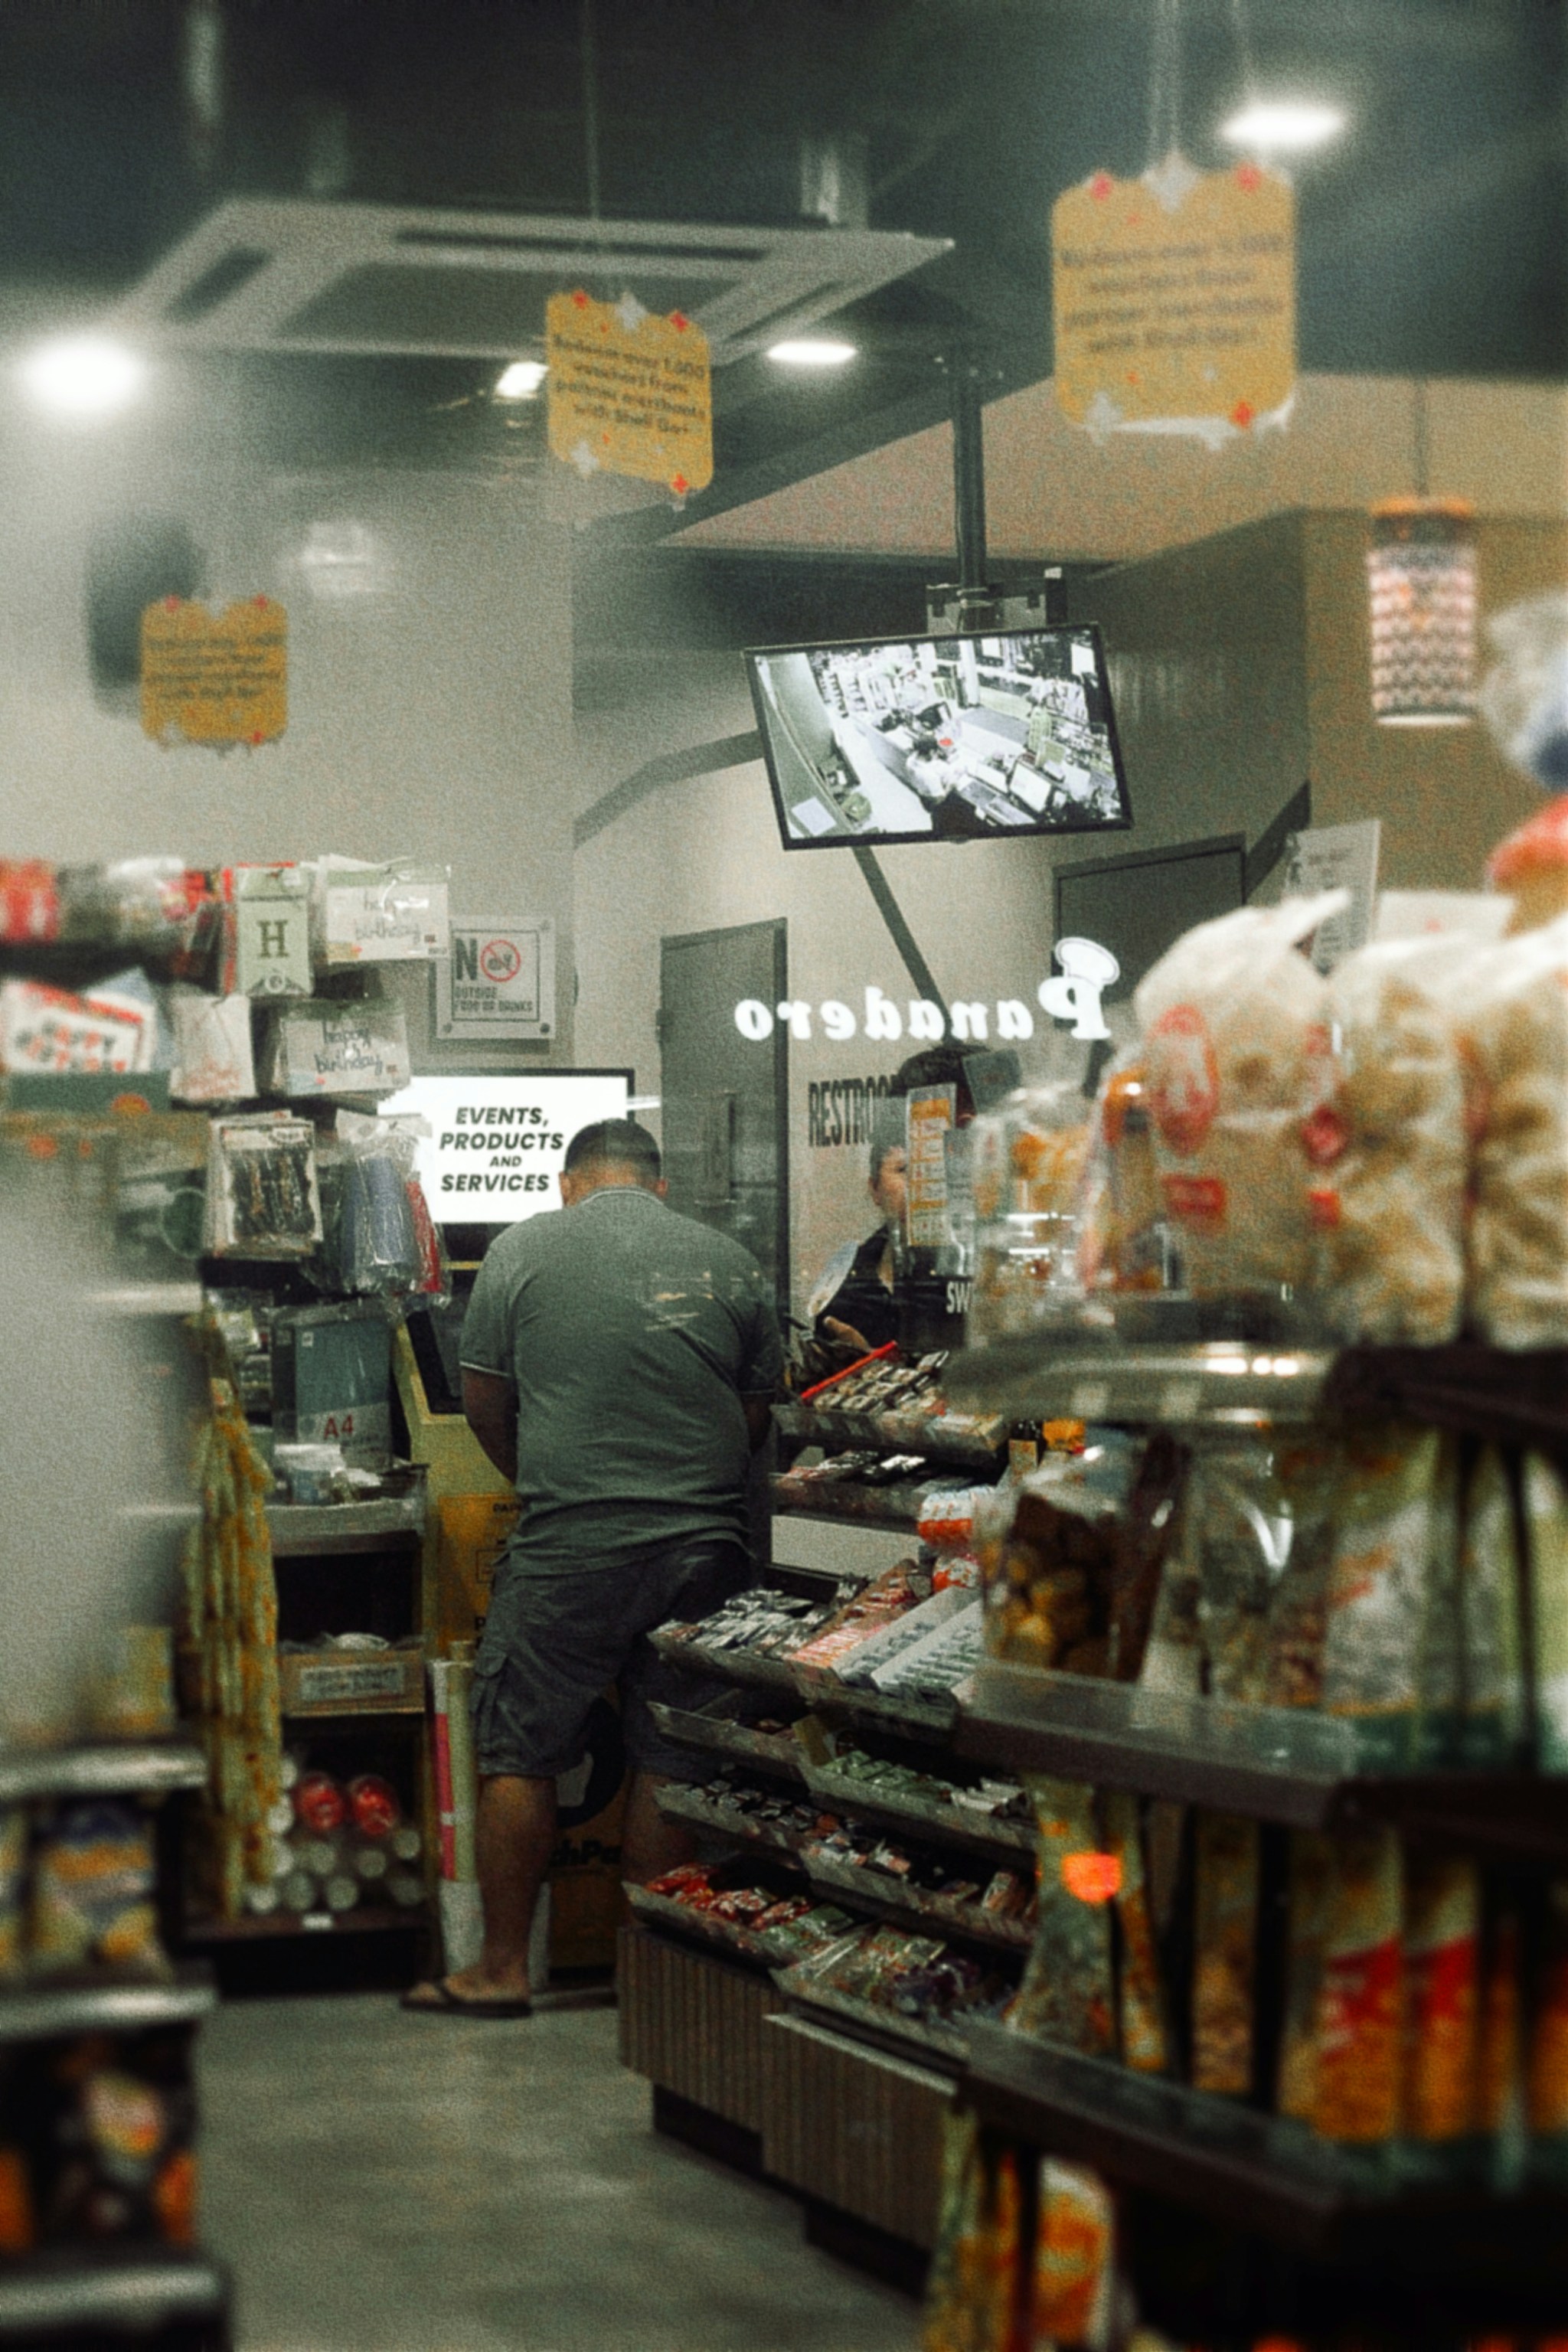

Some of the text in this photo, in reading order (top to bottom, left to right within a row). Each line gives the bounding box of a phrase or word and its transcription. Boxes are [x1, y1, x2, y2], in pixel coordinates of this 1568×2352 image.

[256, 919, 289, 959] H
[322, 1020, 371, 1050] happy
[314, 1044, 384, 1076] birthday
[456, 1106, 550, 1128] EVENTS,
[439, 1132, 564, 1151] PRODUCTS
[489, 1155, 523, 1168] AND
[440, 1173, 550, 1192] SERVICES
[323, 1413, 354, 1442] A4
